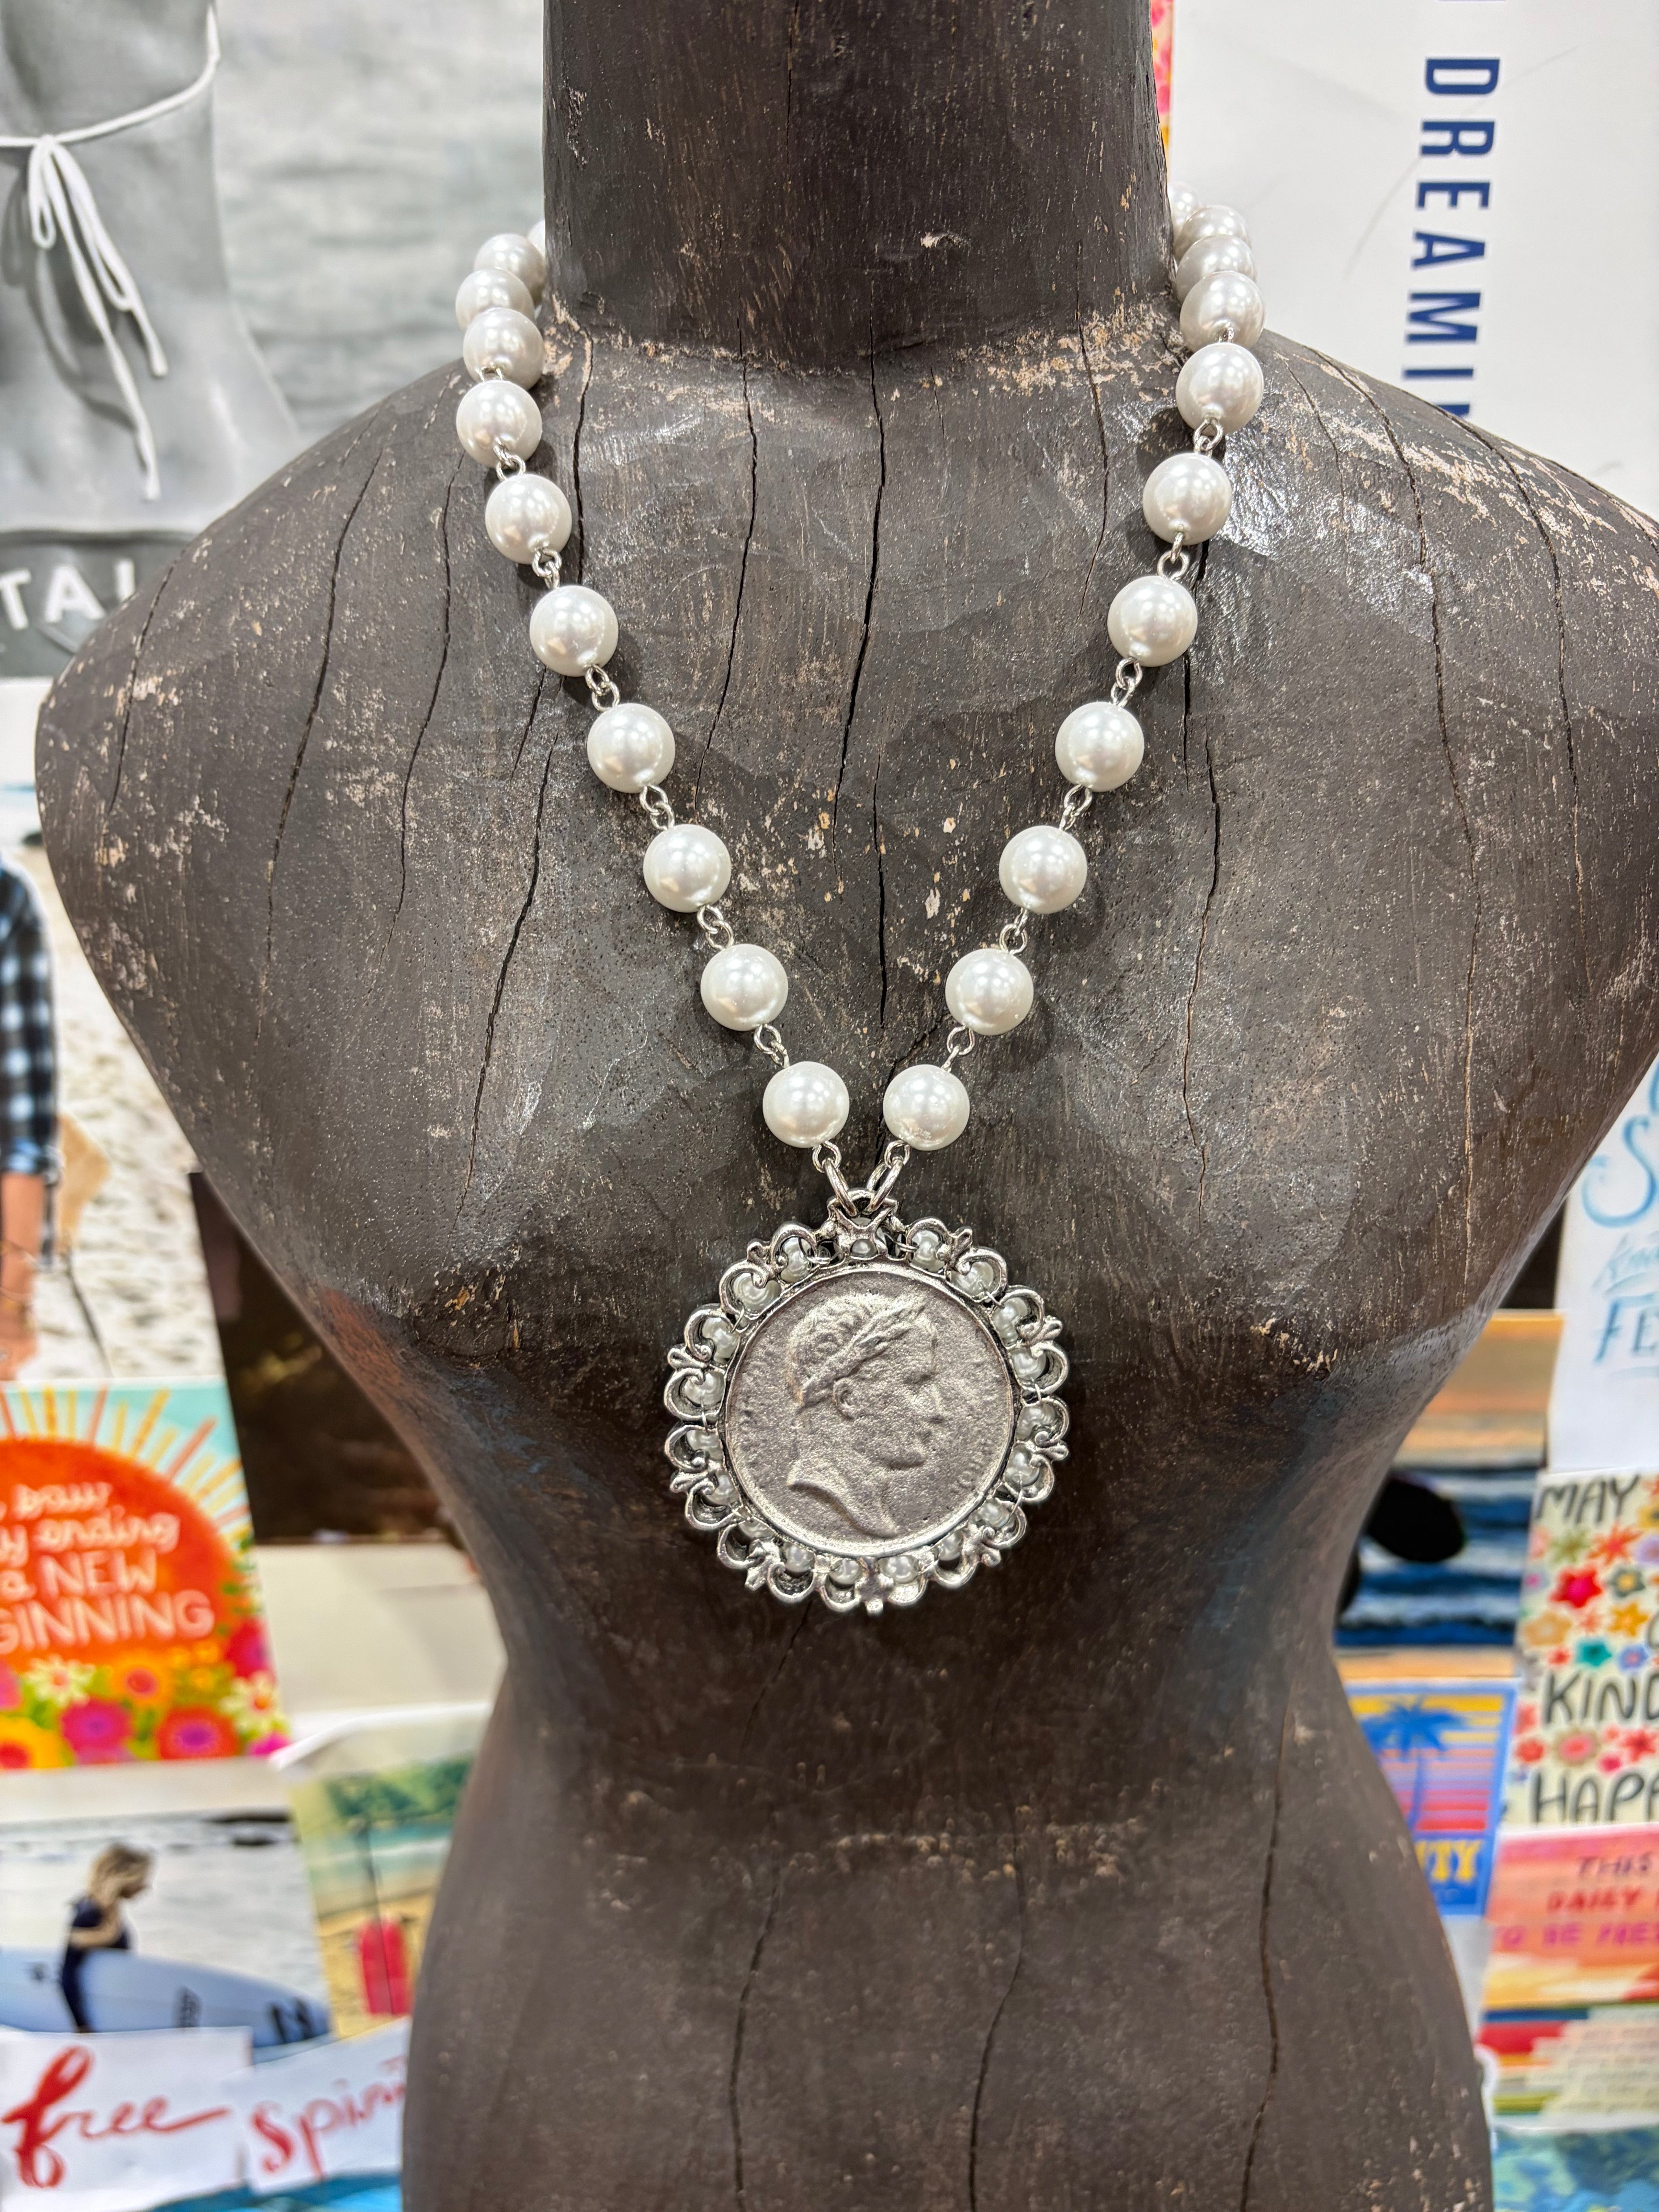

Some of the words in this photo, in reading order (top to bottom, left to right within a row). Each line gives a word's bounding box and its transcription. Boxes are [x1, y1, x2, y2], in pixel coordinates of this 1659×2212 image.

[1537, 1475, 1640, 1524] MAY
[40, 1548, 157, 1598] NEW
[1578, 1851, 1653, 1879] THIS
[2, 2046, 230, 2188] free
